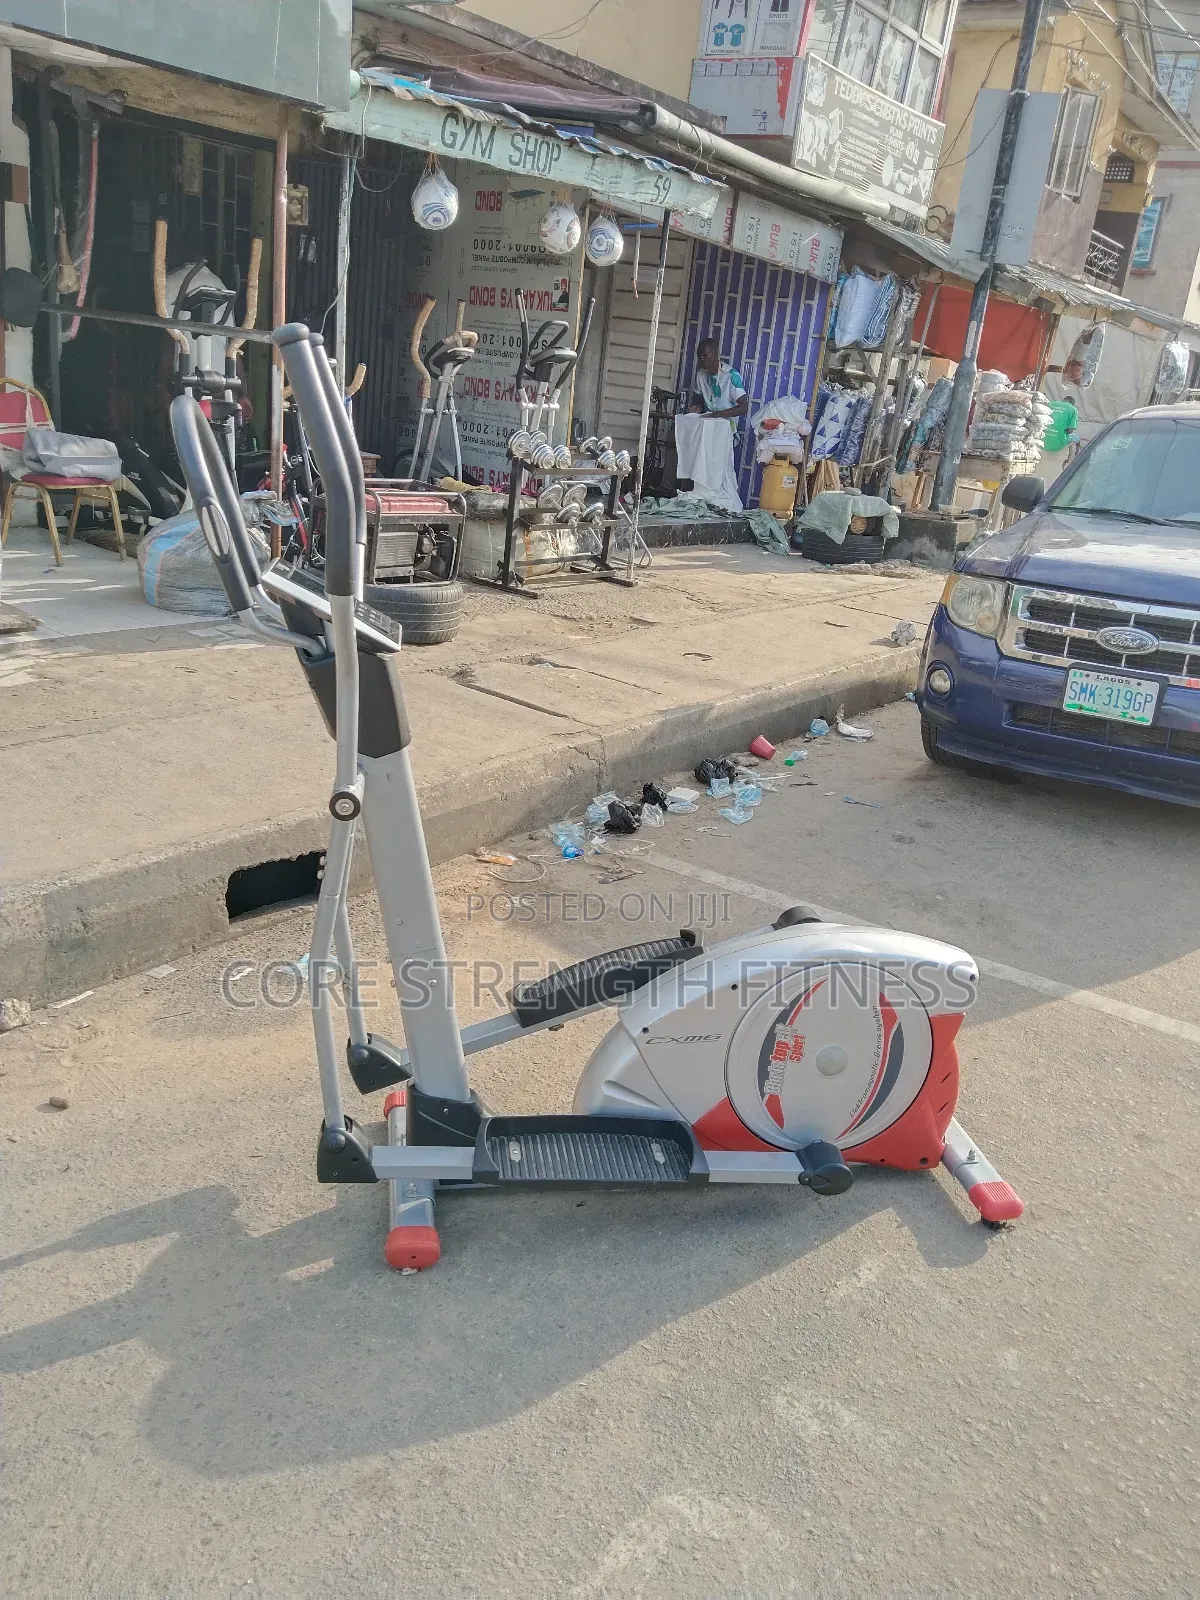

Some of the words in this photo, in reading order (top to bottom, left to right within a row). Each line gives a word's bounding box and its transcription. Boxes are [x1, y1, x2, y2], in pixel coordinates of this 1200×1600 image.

[906, 115, 938, 145] PRINTS
[440, 113, 496, 161] GYM
[508, 131, 562, 175] SHOP
[651, 174, 672, 205] 59
[474, 190, 502, 212] BOND
[472, 253, 489, 261] PANEL
[490, 254, 525, 263] COMPOSITE
[469, 285, 496, 306] BOND
[464, 376, 491, 398] BOND
[460, 434, 479, 443] PANEL
[1110, 632, 1142, 649] Ford
[1095, 674, 1132, 685] LAGOS
[788, 1033, 806, 1063] Sport
